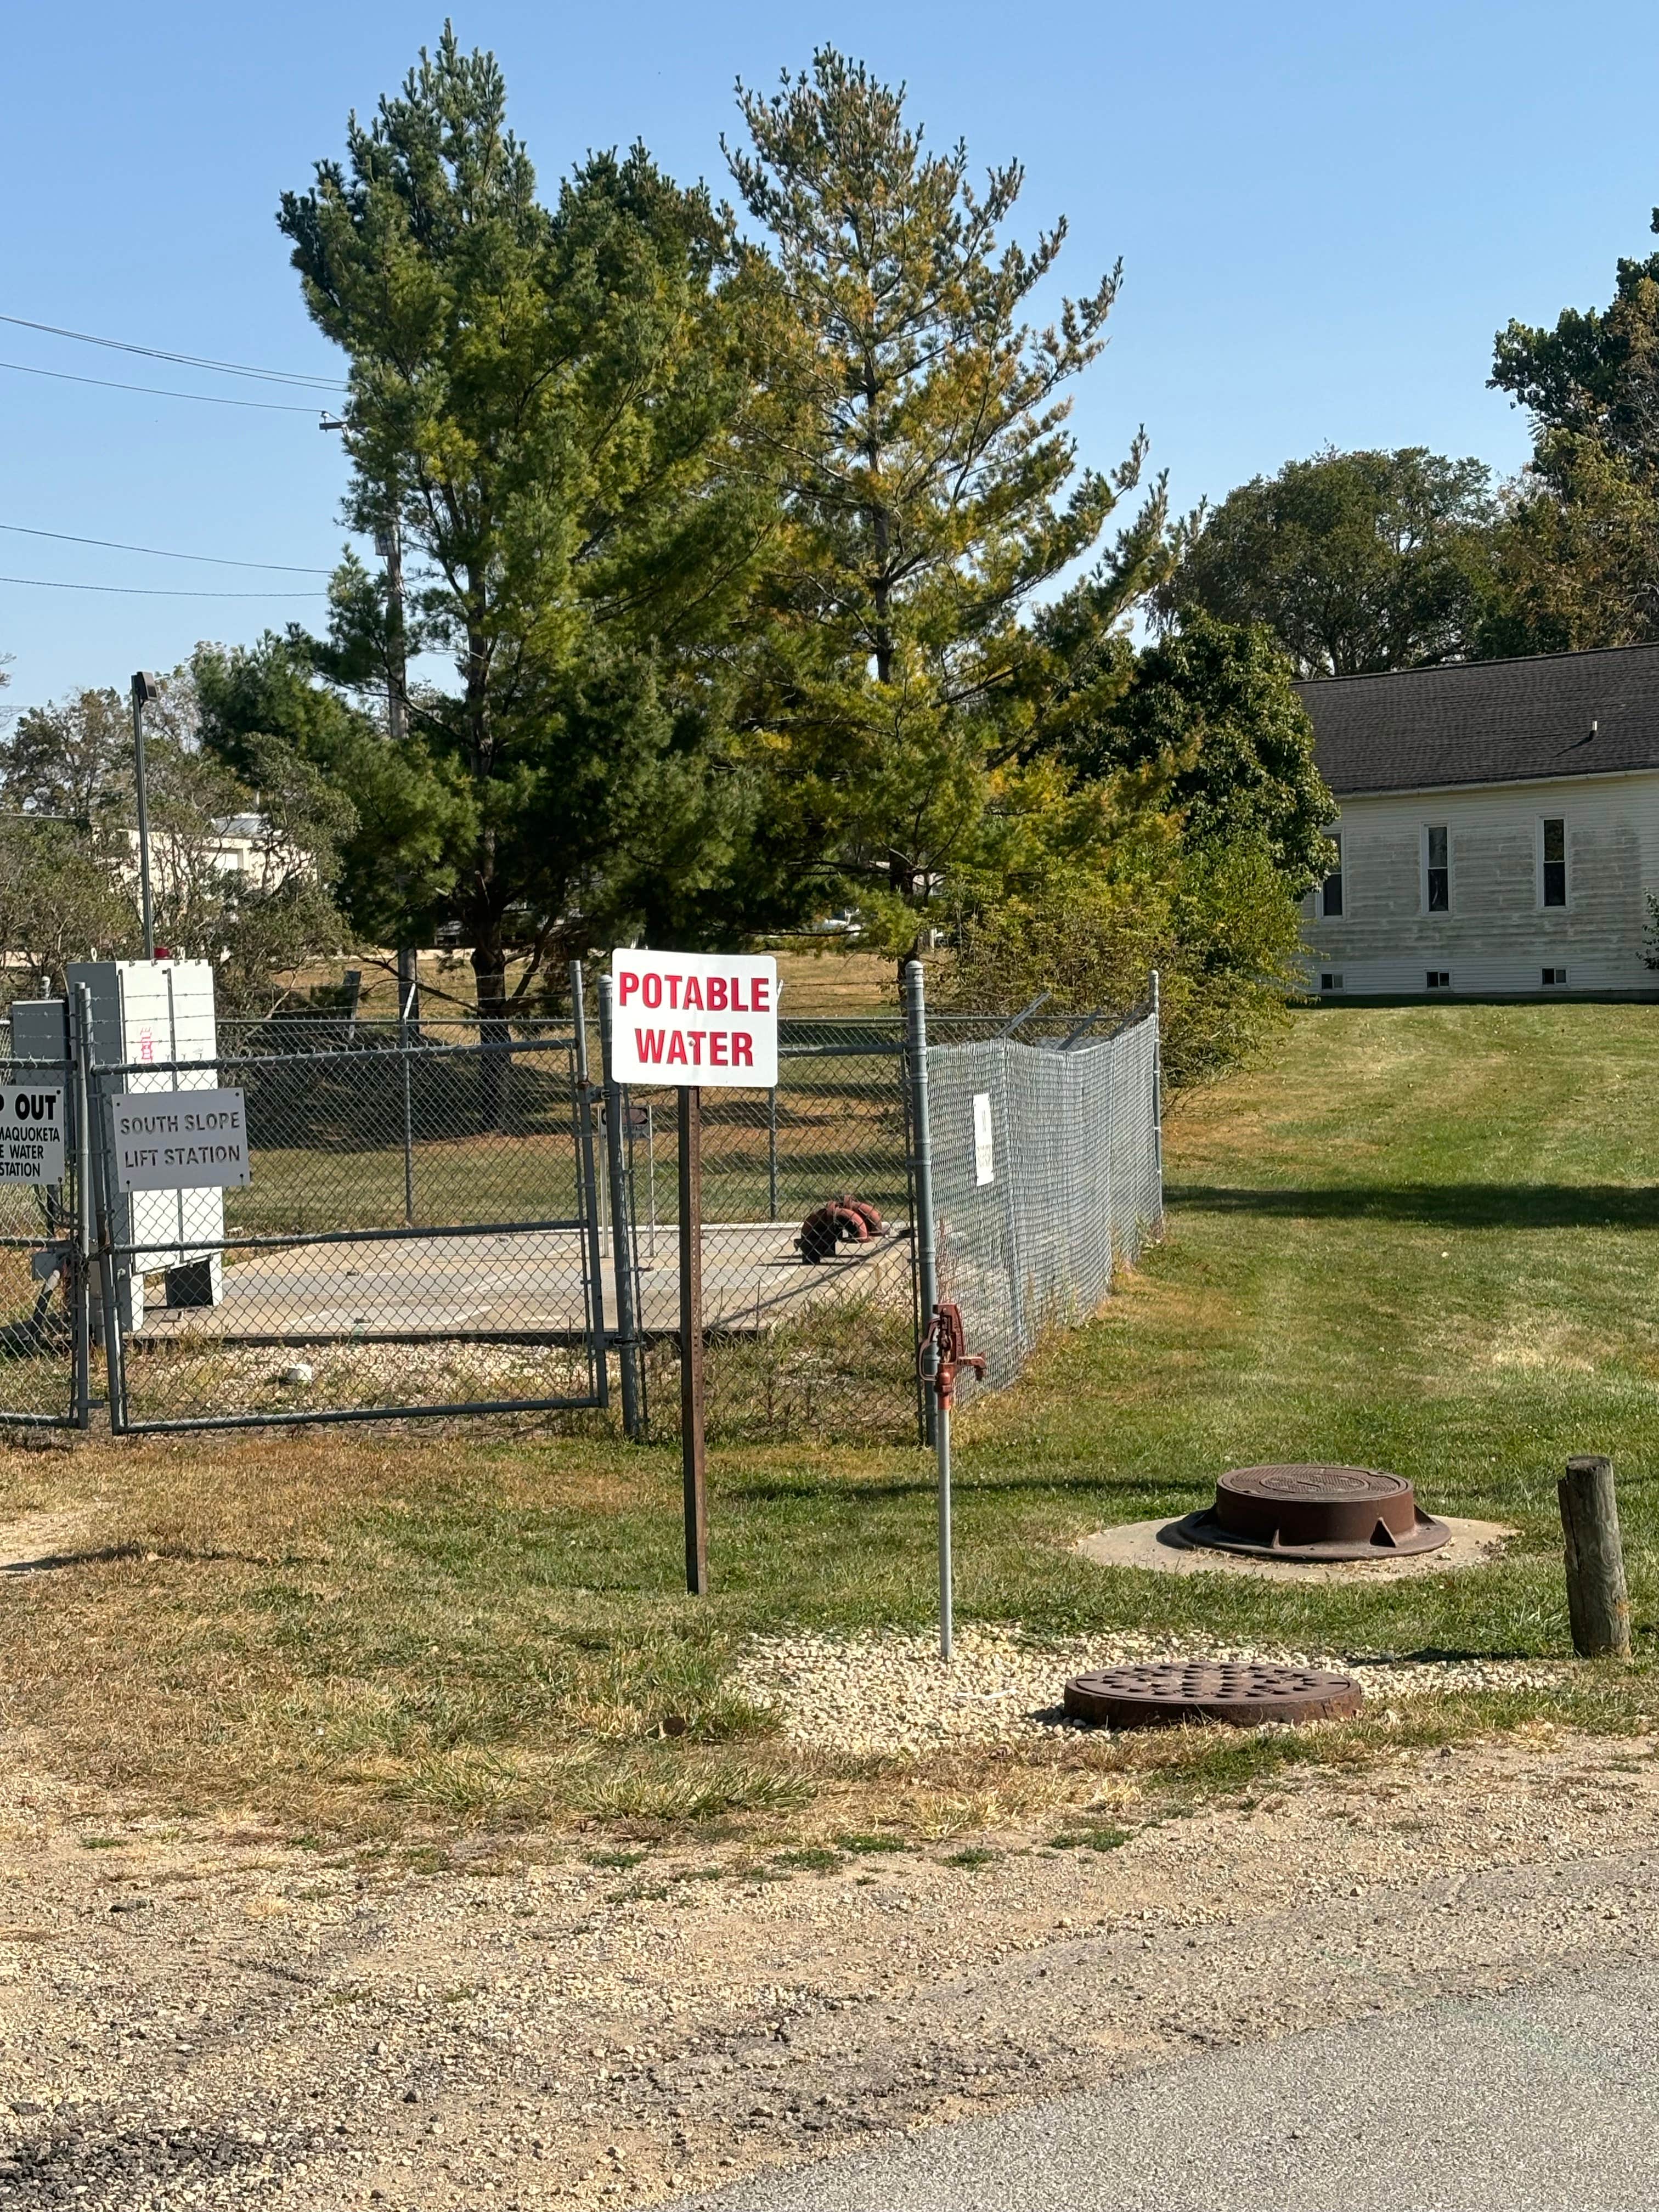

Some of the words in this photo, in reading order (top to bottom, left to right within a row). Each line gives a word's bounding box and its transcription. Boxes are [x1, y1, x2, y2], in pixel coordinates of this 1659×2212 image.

[619, 972, 770, 1012] POTABLE
[635, 1028, 753, 1066] WATER
[15, 1093, 57, 1120] OUT
[120, 1115, 178, 1135] SOUTH
[184, 1111, 240, 1132] SLOPE
[9, 1144, 44, 1159] WATER
[125, 1149, 158, 1168] LIFT
[163, 1145, 240, 1166] STATION
[0, 1161, 41, 1177] STATION
